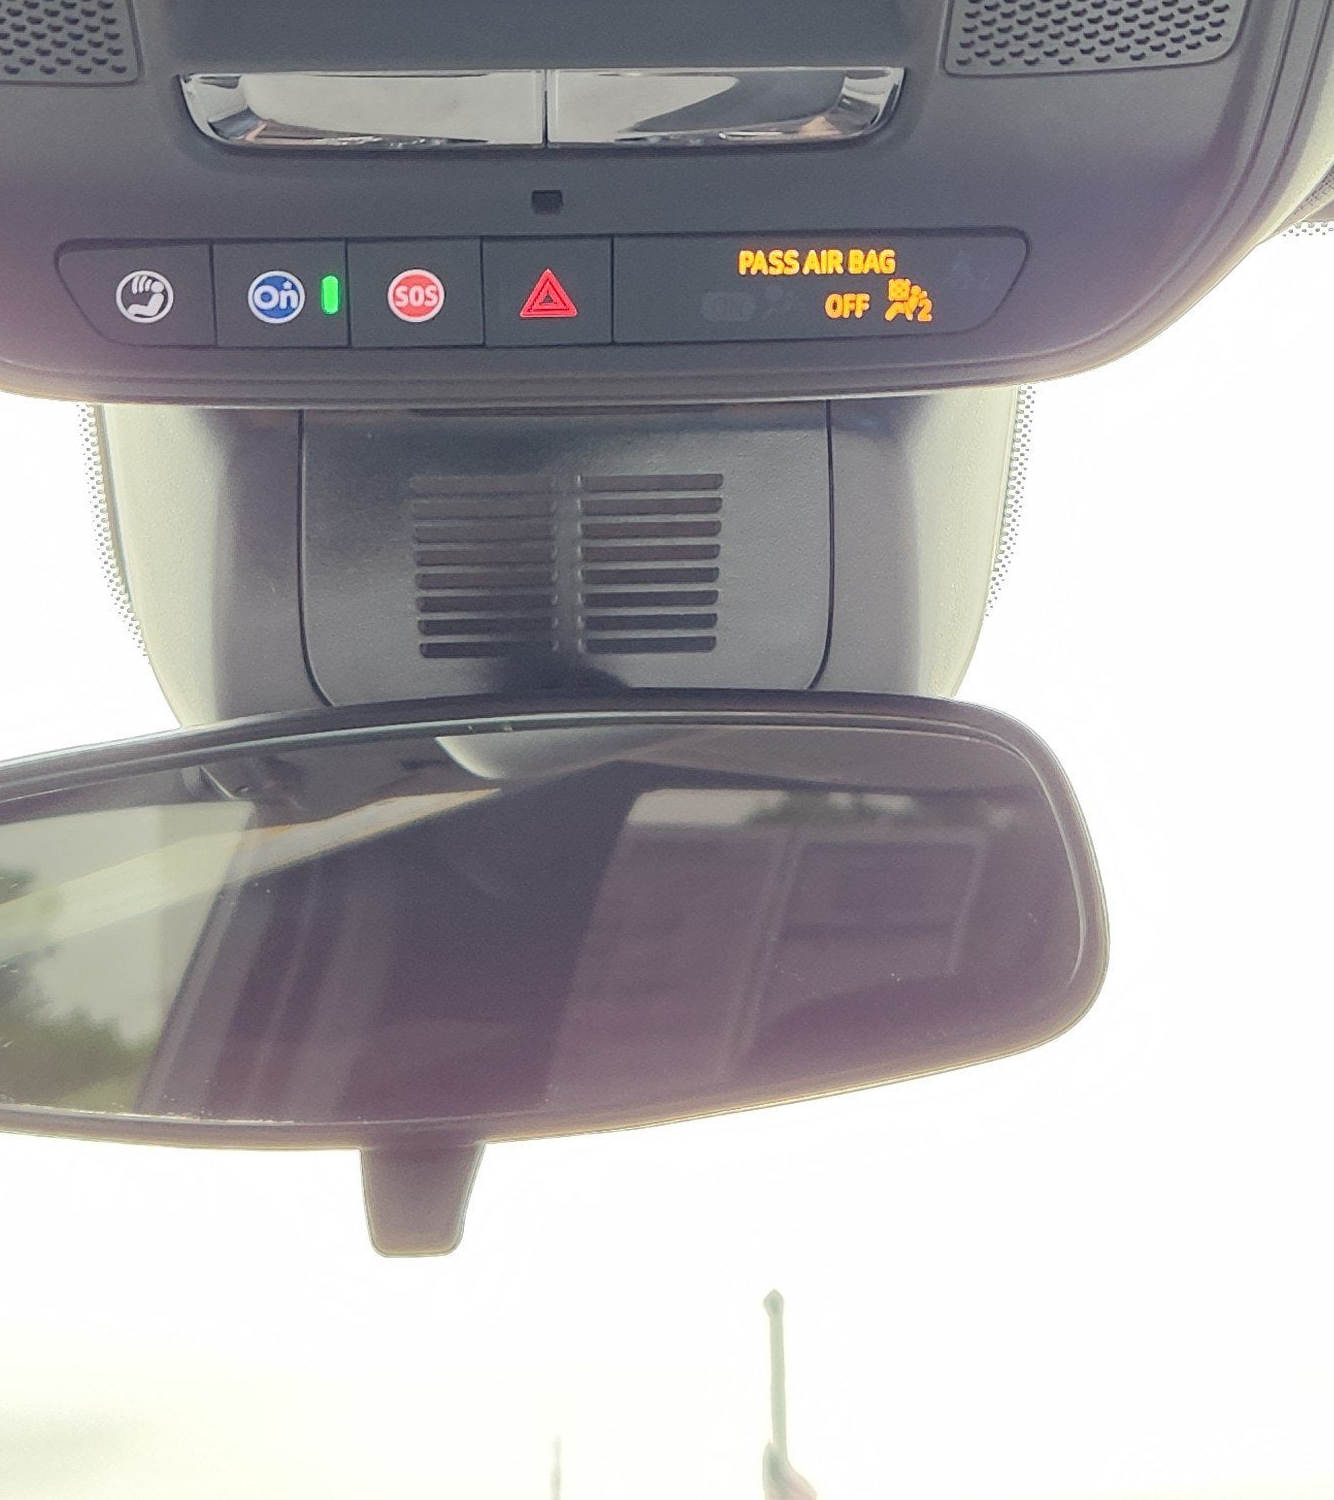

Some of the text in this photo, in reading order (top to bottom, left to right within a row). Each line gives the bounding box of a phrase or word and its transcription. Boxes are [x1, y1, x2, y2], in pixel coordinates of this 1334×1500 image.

[739, 250, 895, 275] PASS AIR BAG
[255, 281, 299, 309] On
[394, 284, 438, 307] SOS
[825, 293, 869, 318] OFF
